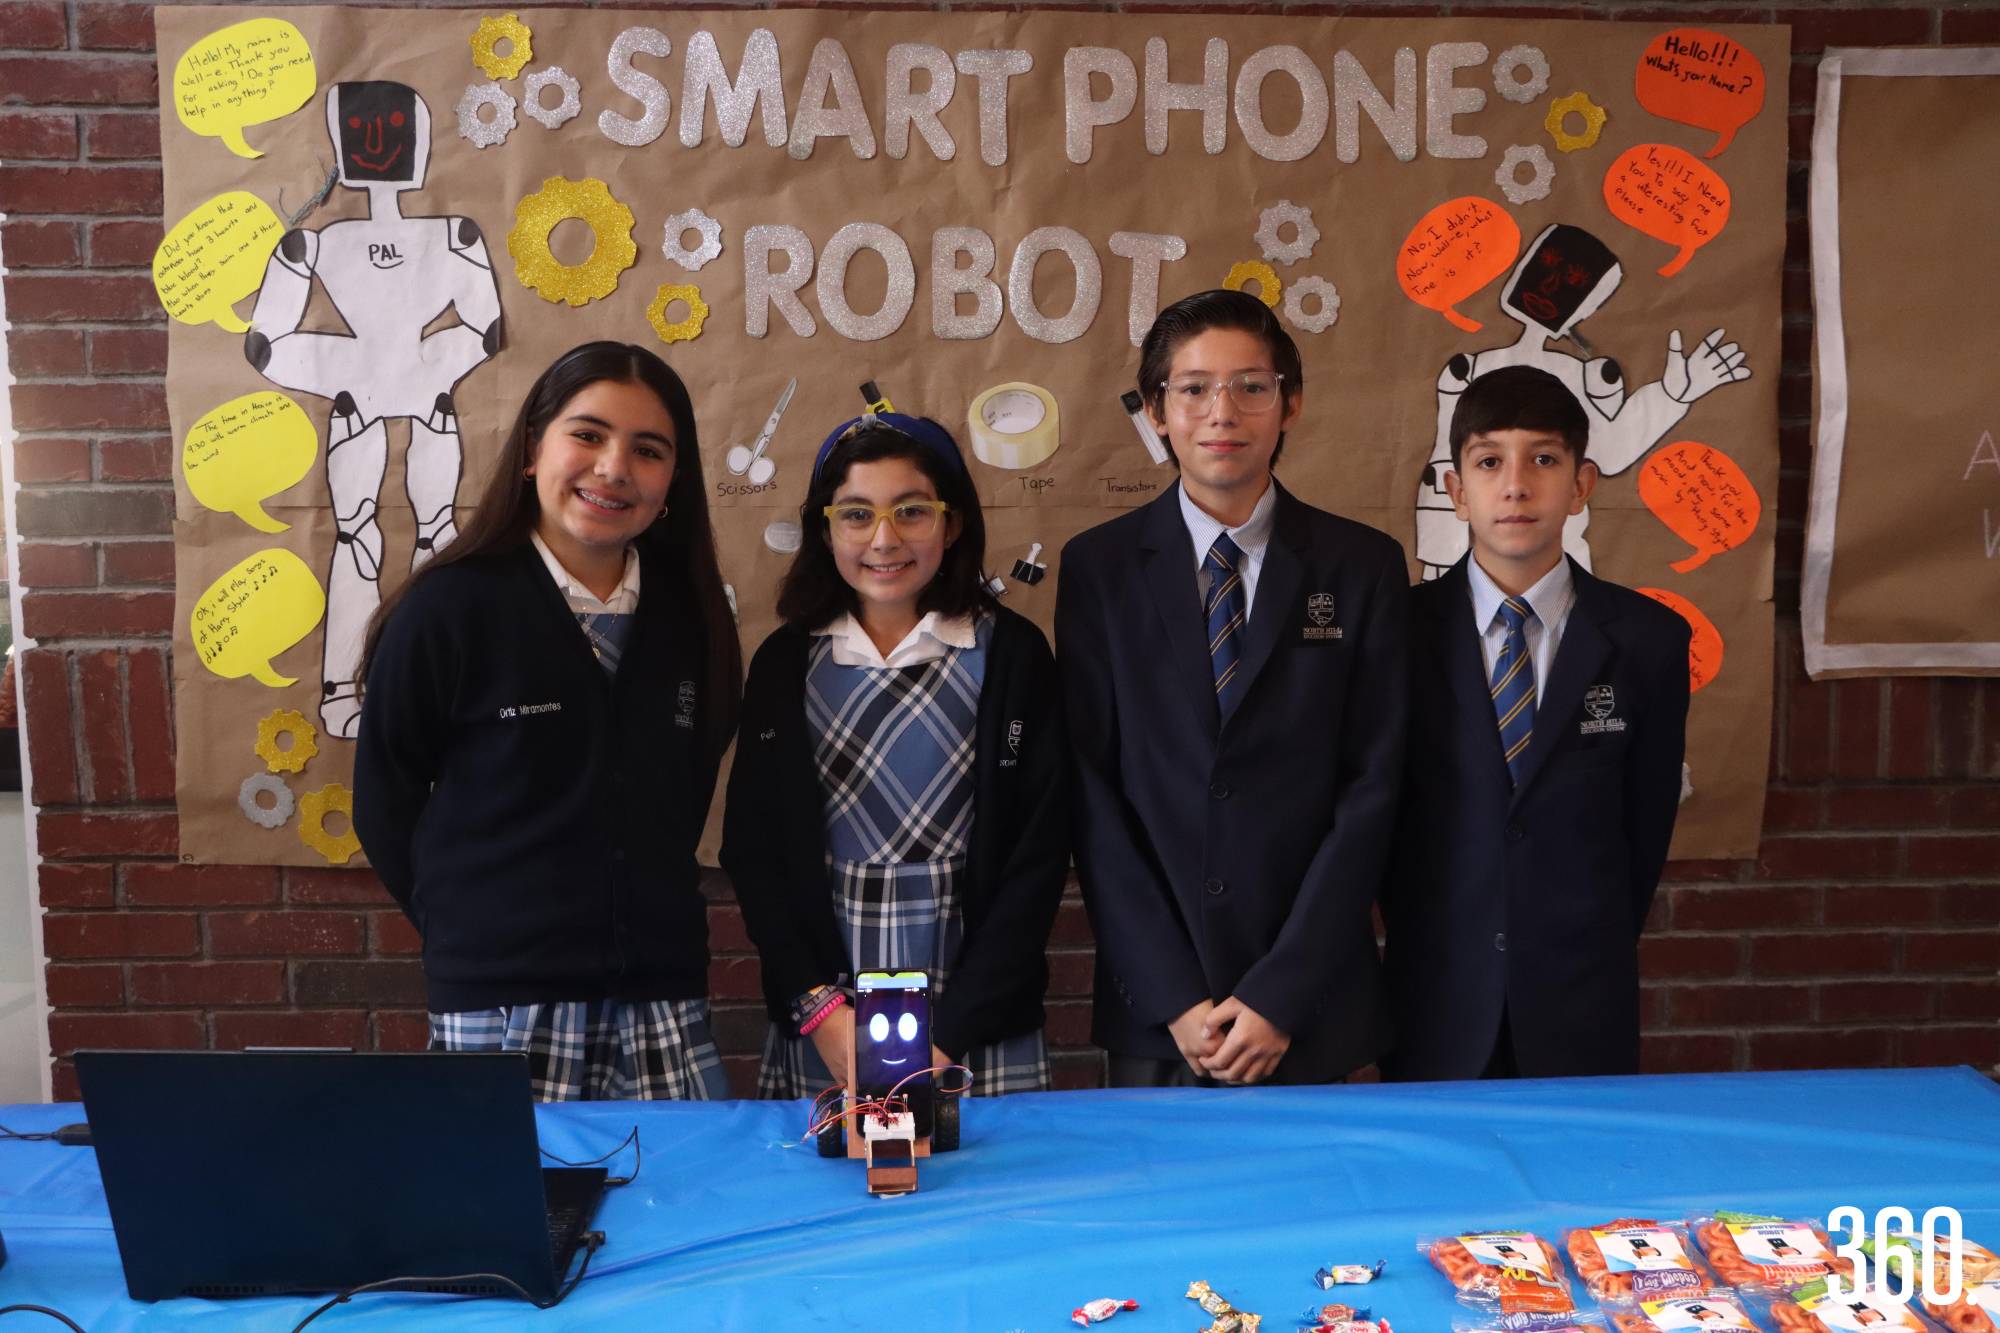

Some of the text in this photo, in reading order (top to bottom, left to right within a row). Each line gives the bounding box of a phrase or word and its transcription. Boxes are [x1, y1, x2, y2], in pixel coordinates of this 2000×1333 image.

[187, 30, 290, 70] Hello! My name is
[228, 50, 263, 70] Thank
[269, 46, 290, 60] you
[1664, 36, 1739, 67] Hello!!!
[268, 64, 284, 77] you
[288, 52, 312, 67] need
[597, 26, 1490, 168] SMART PHONE
[184, 105, 206, 118] help
[1628, 160, 1645, 177] You
[1681, 170, 1695, 184] I
[1697, 181, 1726, 208] Need
[1470, 210, 1493, 229] what
[162, 202, 235, 258] Did you know that
[186, 245, 204, 257] have
[206, 235, 215, 244] 3
[214, 218, 239, 238] hearts
[244, 202, 258, 214] and
[1426, 226, 1442, 240] I
[368, 243, 404, 261] PAL
[1444, 269, 1456, 278] is
[181, 282, 200, 297] when
[744, 222, 1187, 348] ROBOT
[221, 414, 237, 425] time
[1674, 450, 1697, 471] And
[1700, 449, 1727, 477] Thank
[717, 481, 777, 497] Scissors
[1018, 476, 1055, 494] Tape
[1099, 477, 1158, 493] Transistors
[207, 616, 230, 634] Harry
[500, 702, 562, 719] Ortiz Miramontes
